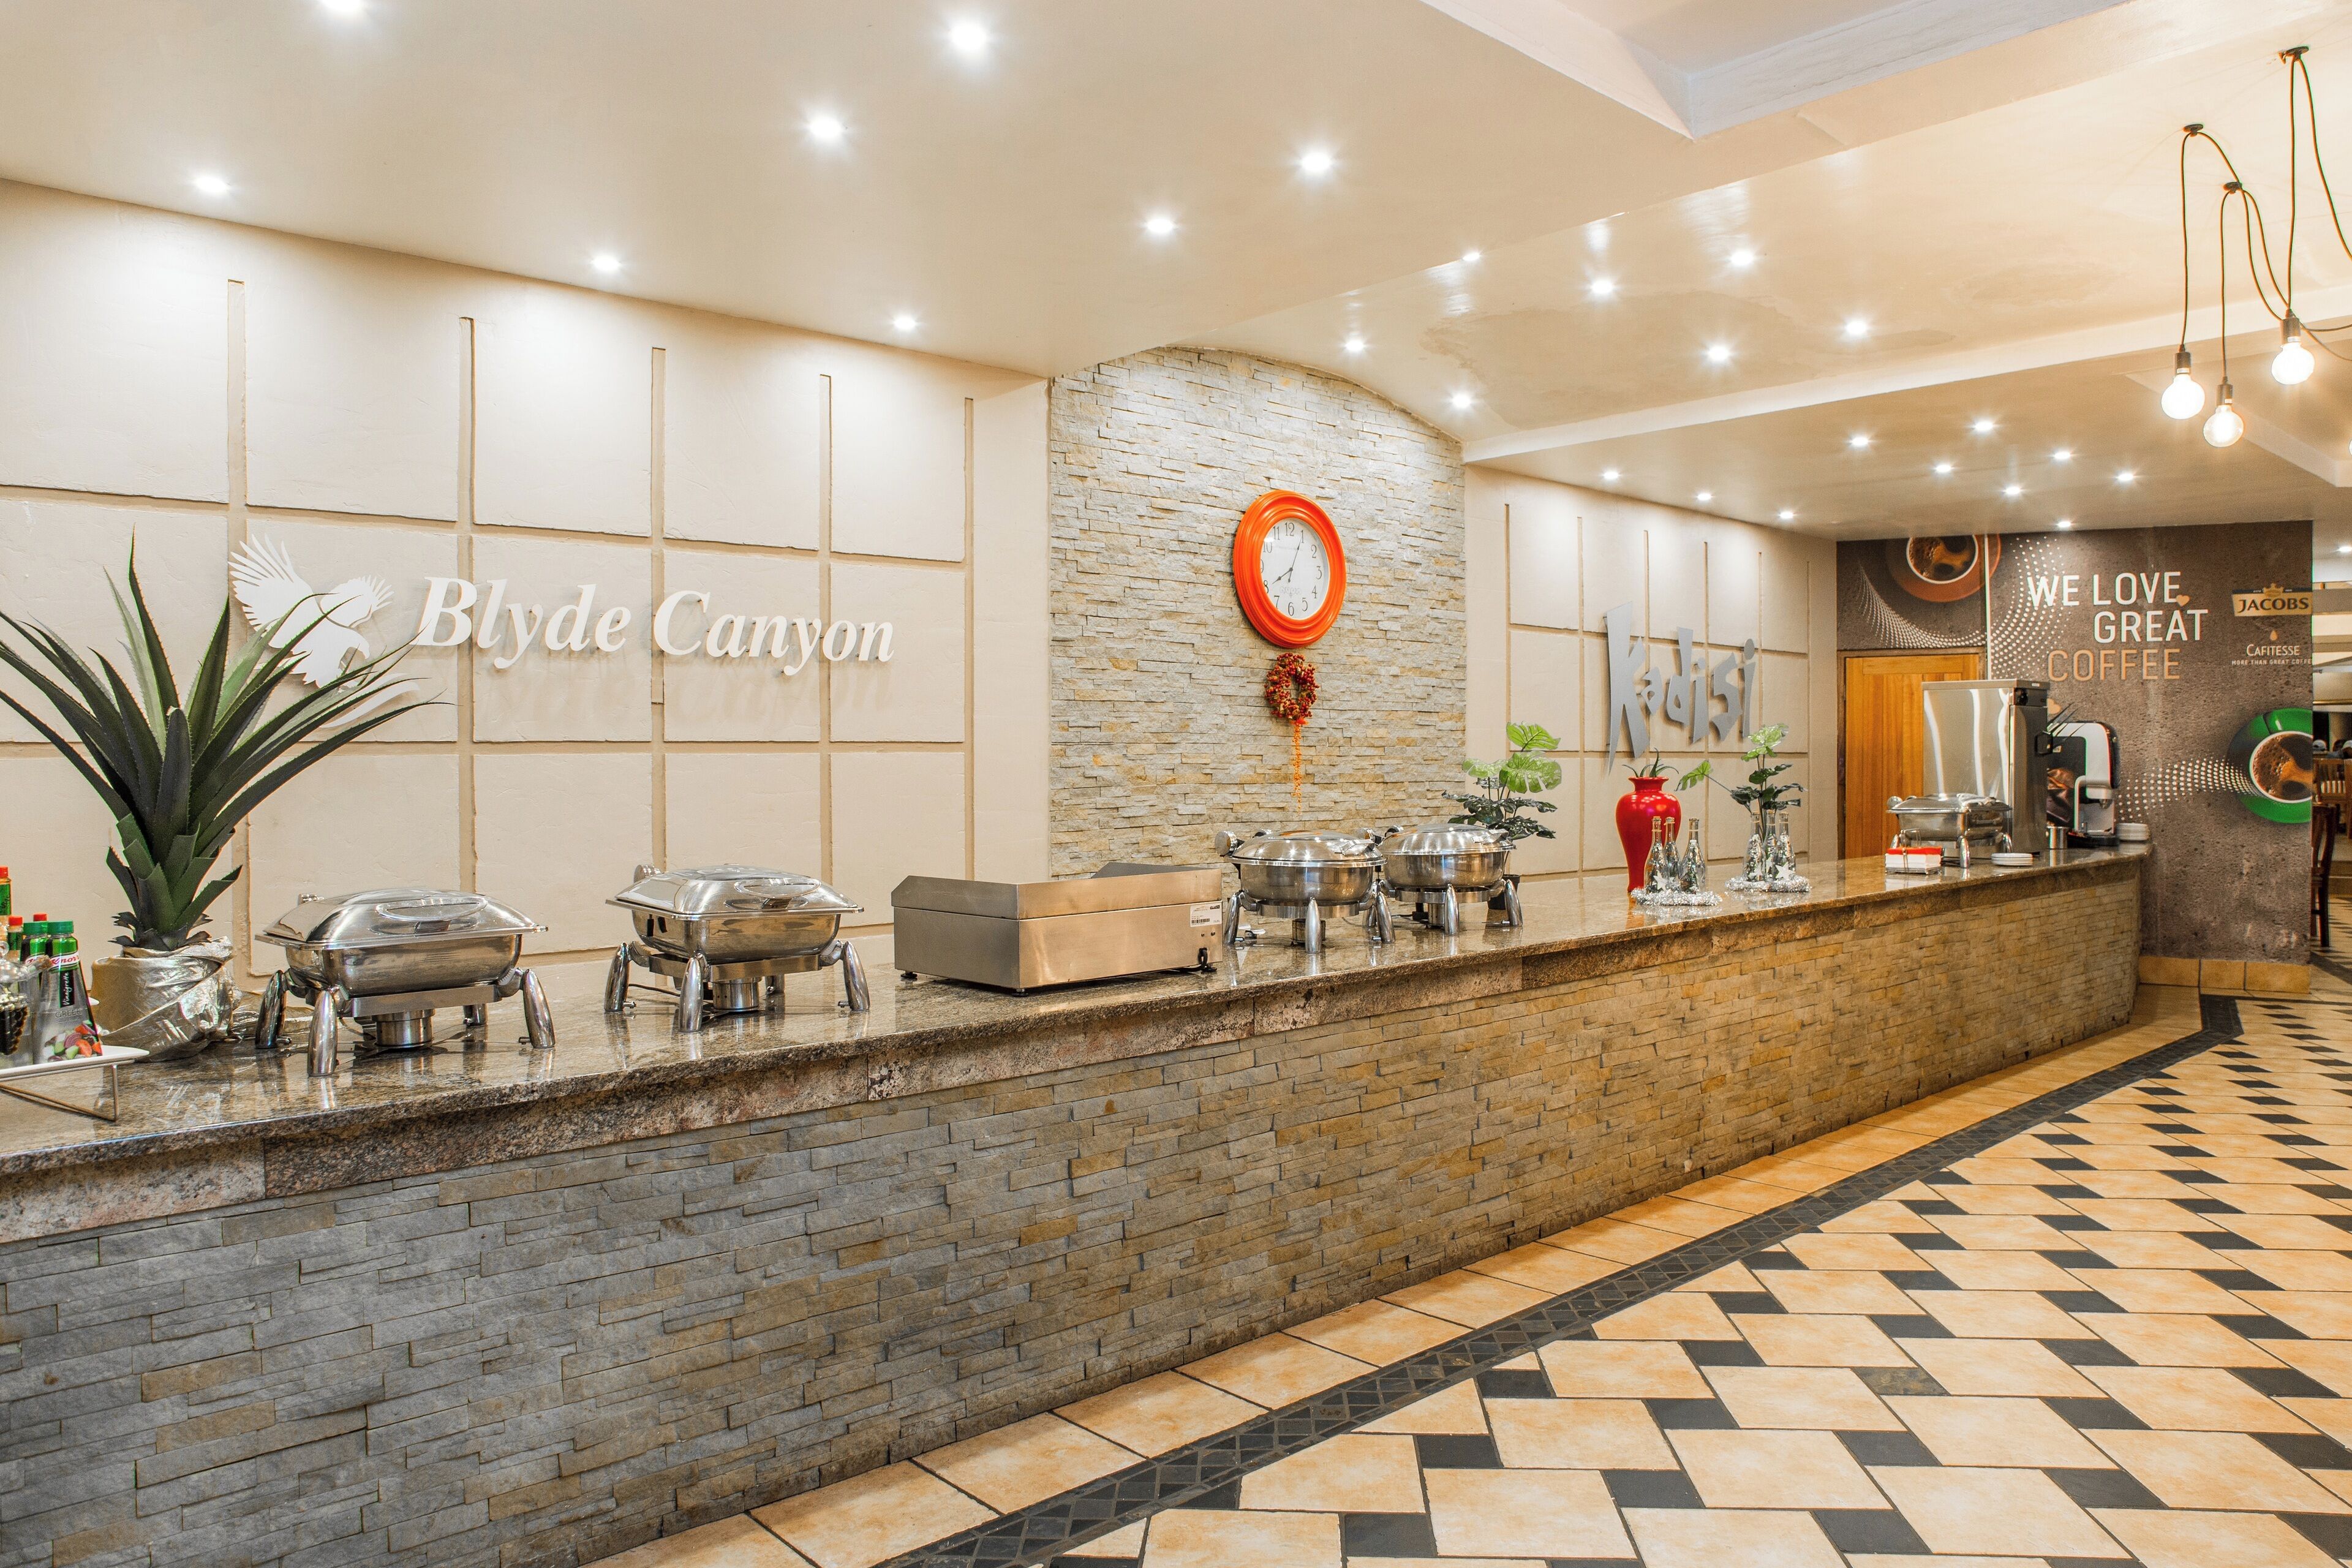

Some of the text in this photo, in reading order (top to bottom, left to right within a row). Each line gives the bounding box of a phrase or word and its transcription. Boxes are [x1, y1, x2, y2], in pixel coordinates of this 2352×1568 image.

[1273, 526, 1280, 540] 11
[1285, 522, 1295, 537] 12
[1300, 530, 1305, 543] 1
[1263, 540, 1272, 553] 10
[1311, 545, 1317, 558] 2
[1316, 566, 1322, 579] 3
[1264, 580, 1269, 594] 8
[1312, 586, 1317, 598] 4
[2027, 571, 2181, 606] WE LOVE
[1274, 595, 1280, 609] 7
[1288, 602, 1294, 616] 6
[1302, 598, 1308, 611] 5
[2237, 597, 2309, 613] JACOBS
[409, 576, 895, 676] Blyde Canyon
[2094, 609, 2209, 644] GREAT
[2048, 649, 2180, 682] COFFEE
[1607, 601, 1756, 777] Kadisi
[62, 972, 72, 1005] Vinaigrette
